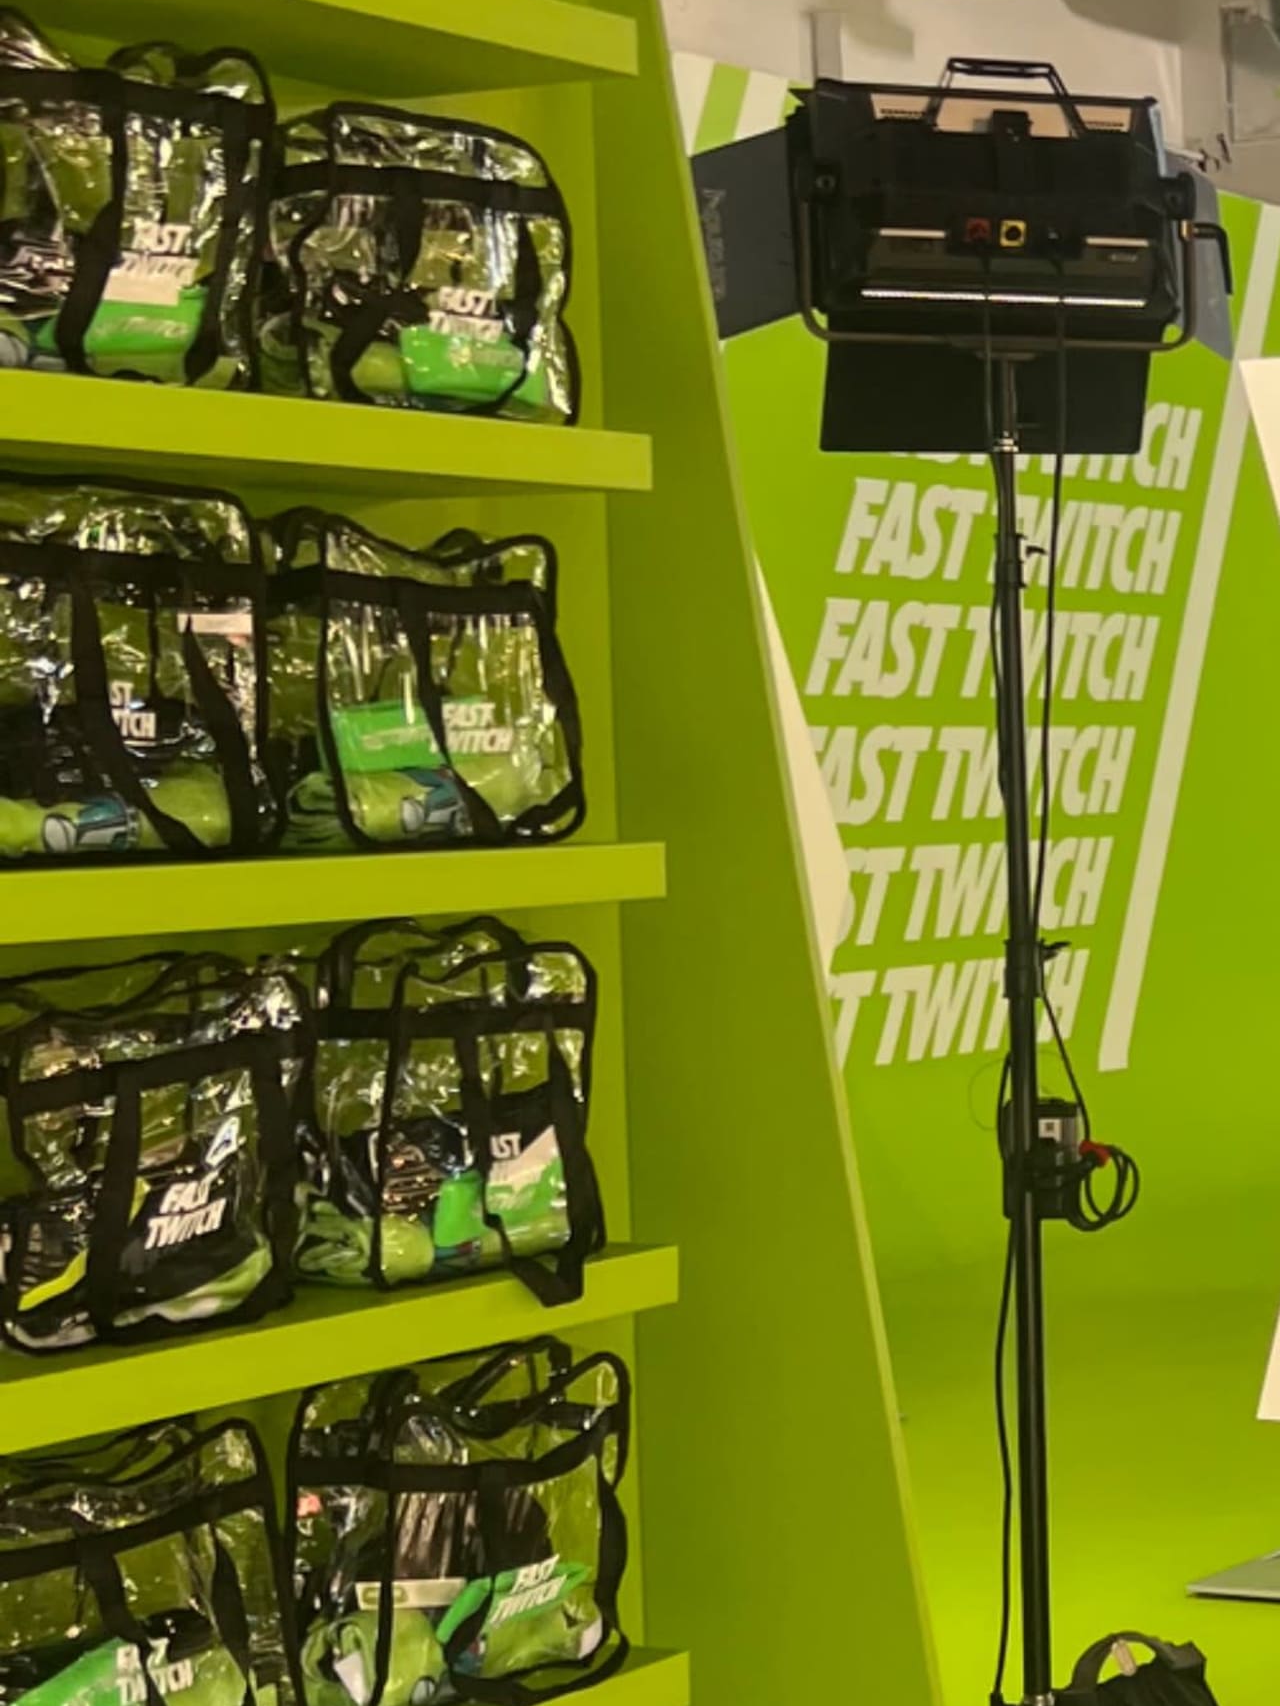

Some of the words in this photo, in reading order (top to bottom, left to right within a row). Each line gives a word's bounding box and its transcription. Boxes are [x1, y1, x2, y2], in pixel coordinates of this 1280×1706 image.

[834, 477, 988, 582] FAST
[803, 597, 963, 699] FAST
[873, 948, 1090, 1067] TWITH
[145, 1198, 227, 1250] TWITCH
[511, 1555, 560, 1594] FAST
